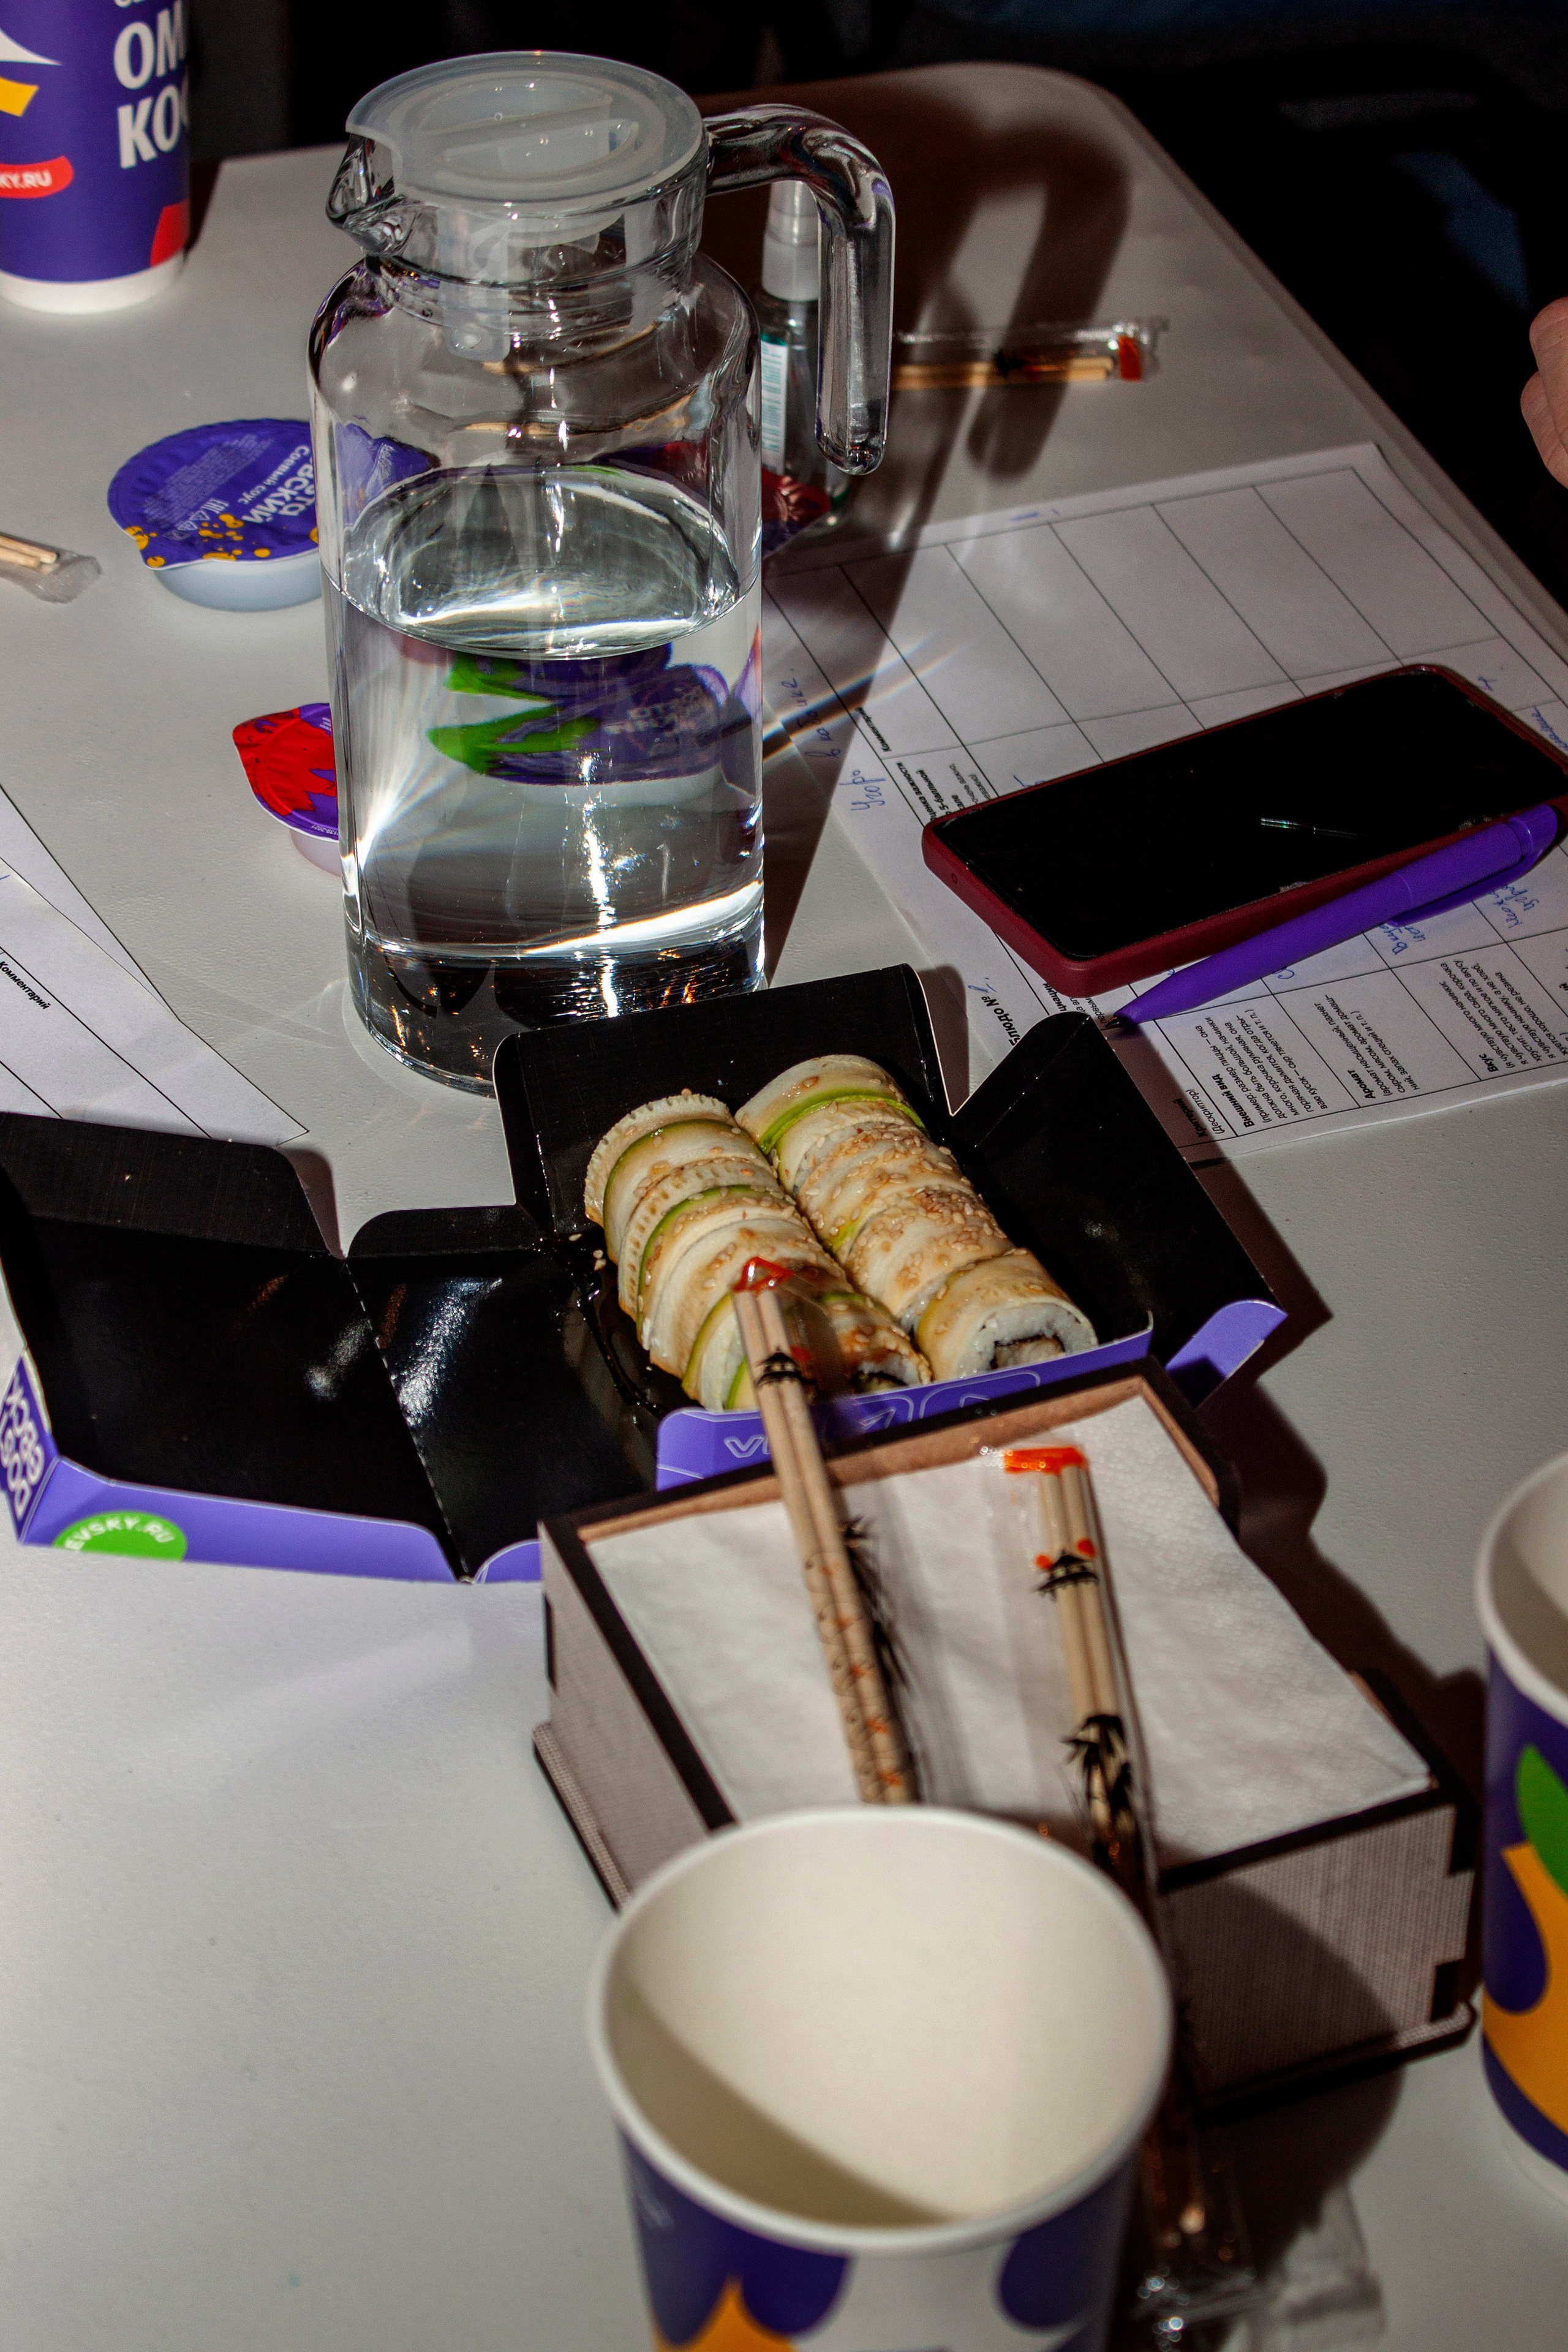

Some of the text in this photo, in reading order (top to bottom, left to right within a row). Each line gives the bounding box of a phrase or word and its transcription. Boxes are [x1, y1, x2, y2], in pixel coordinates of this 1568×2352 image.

[238, 445, 310, 505] Соевый соус
[896, 762, 922, 796] важности
[1440, 963, 1466, 990] корочка
[1453, 960, 1472, 978] вкусу
[1471, 963, 1490, 981] хлеб,
[0, 961, 51, 1009] Комментарий
[1468, 978, 1479, 987] по
[1487, 981, 1498, 990] не
[1495, 972, 1521, 996] резина
[1464, 990, 1481, 1009] сыра,
[1480, 993, 1503, 1017] мягкое
[1499, 995, 1526, 1024] начинку,
[1515, 997, 1526, 1005] не
[1463, 1011, 1483, 1031] много
[1477, 1009, 1499, 1030] много
[1500, 1017, 1518, 1036] тесто
[1523, 1005, 1550, 1033] хорошо,
[1195, 1025, 1208, 1038] она
[1262, 1030, 1286, 1056] тянется
[1344, 1021, 1368, 1045] аромат
[1367, 1031, 1392, 1055] специй
[1522, 1024, 1551, 1054] чувствую
[1210, 1045, 1230, 1067] пиццы
[1250, 1035, 1269, 1054] когда
[1314, 1003, 1393, 1096] (аромат насыщенный, пахнет
[1480, 1031, 1509, 1062] чувствую
[1495, 1030, 1524, 1060] чувствую
[1516, 1035, 1542, 1062] хрустит,
[1205, 1017, 1288, 1119] должна быть большой, начинки
[1224, 1022, 1300, 1116] много, корочка румяная, она
[1266, 1054, 1294, 1084] дымится,
[1283, 1056, 1297, 1069] сыр
[1365, 1045, 1387, 1069] мясом,
[1388, 1055, 1408, 1076] запах
[1479, 1054, 1499, 1072] Вкус
[1226, 1067, 1251, 1093] размер
[1298, 1076, 1317, 1096] кусок
[1347, 1070, 1376, 1099] Аромат
[1384, 1069, 1406, 1093] сыром,
[1403, 1075, 1420, 1090] ний,
[1212, 1074, 1255, 1128] Внешний вид
[1245, 1093, 1272, 1123] (пример:
[1288, 1085, 1314, 1113] горячая
[1313, 1096, 1328, 1109] ваю
[1172, 1098, 1208, 1138] Критерий
[1185, 1089, 1225, 1134] (Дескриптор)
